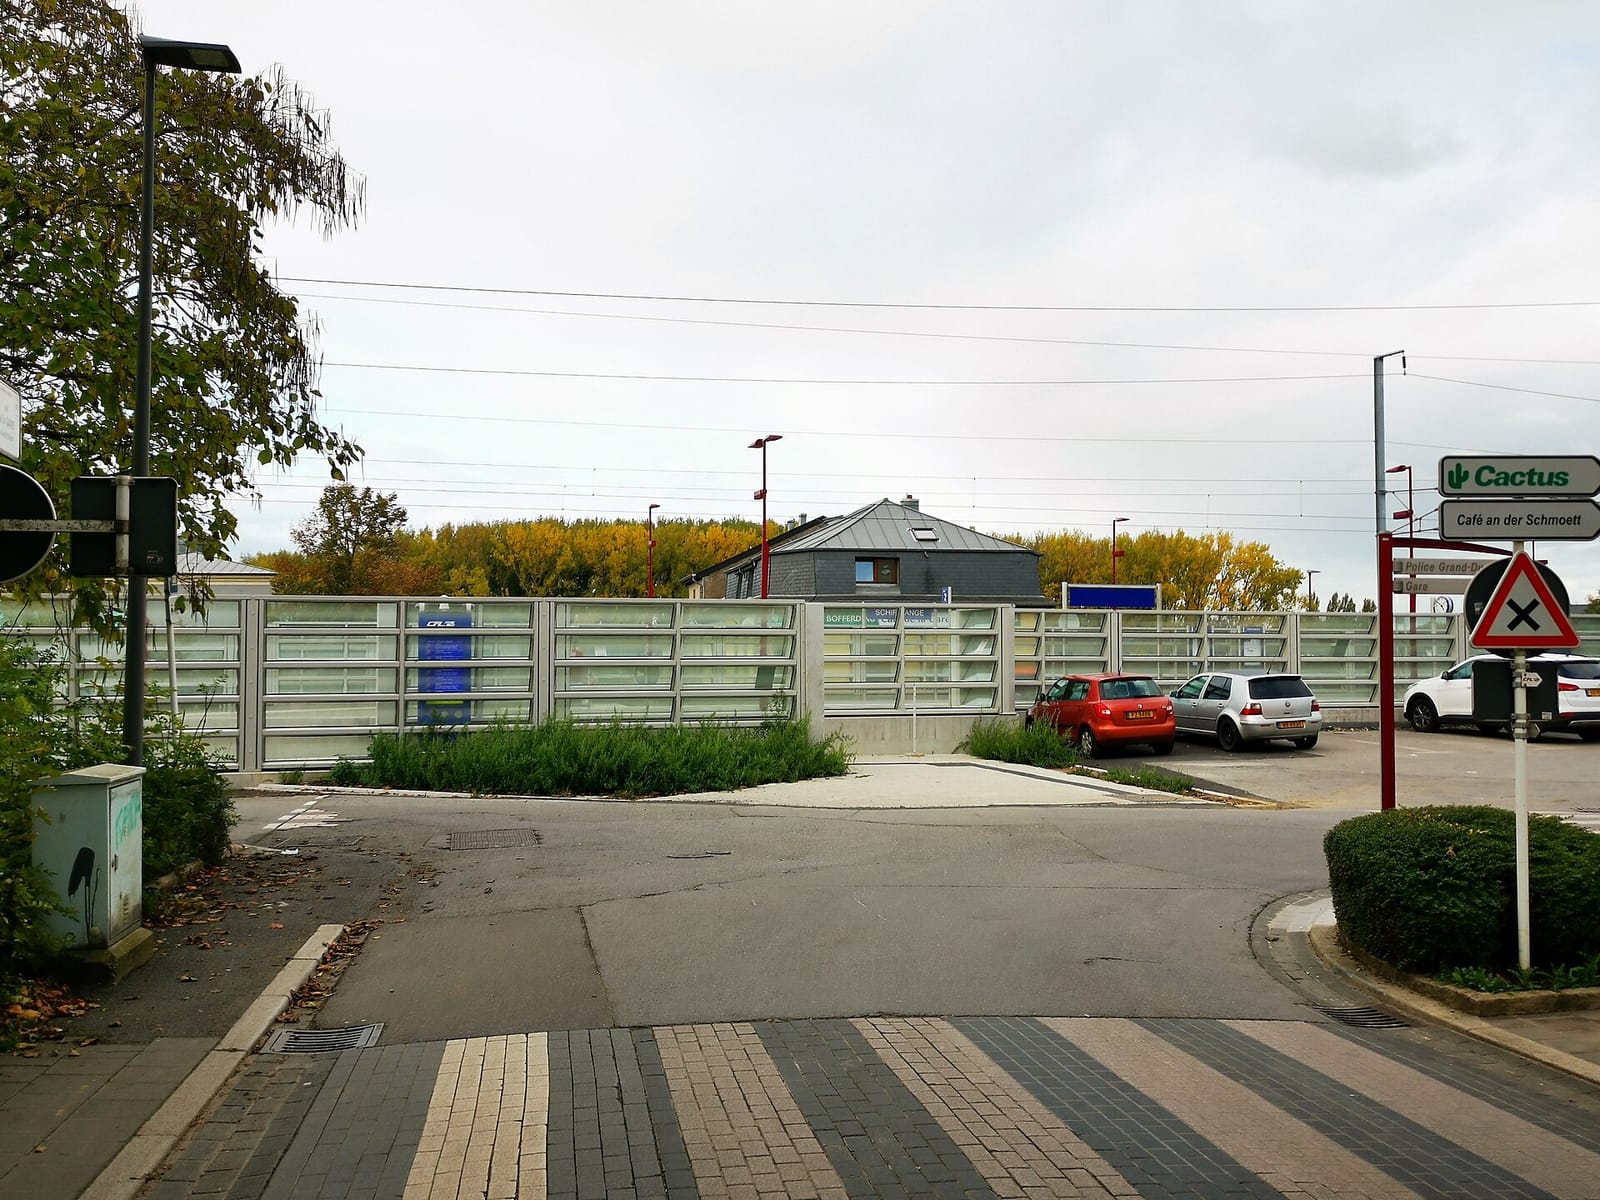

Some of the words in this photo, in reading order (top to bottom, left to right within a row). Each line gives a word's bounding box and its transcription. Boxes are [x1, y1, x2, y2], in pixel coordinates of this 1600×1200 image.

[1475, 465, 1569, 487] Cactus
[1457, 513, 1483, 526] Café
[1486, 515, 1500, 526] an
[1504, 514, 1523, 526] der
[1526, 514, 1581, 526] Schmoett
[1405, 562, 1435, 572] Police
[1405, 581, 1428, 591] Gare
